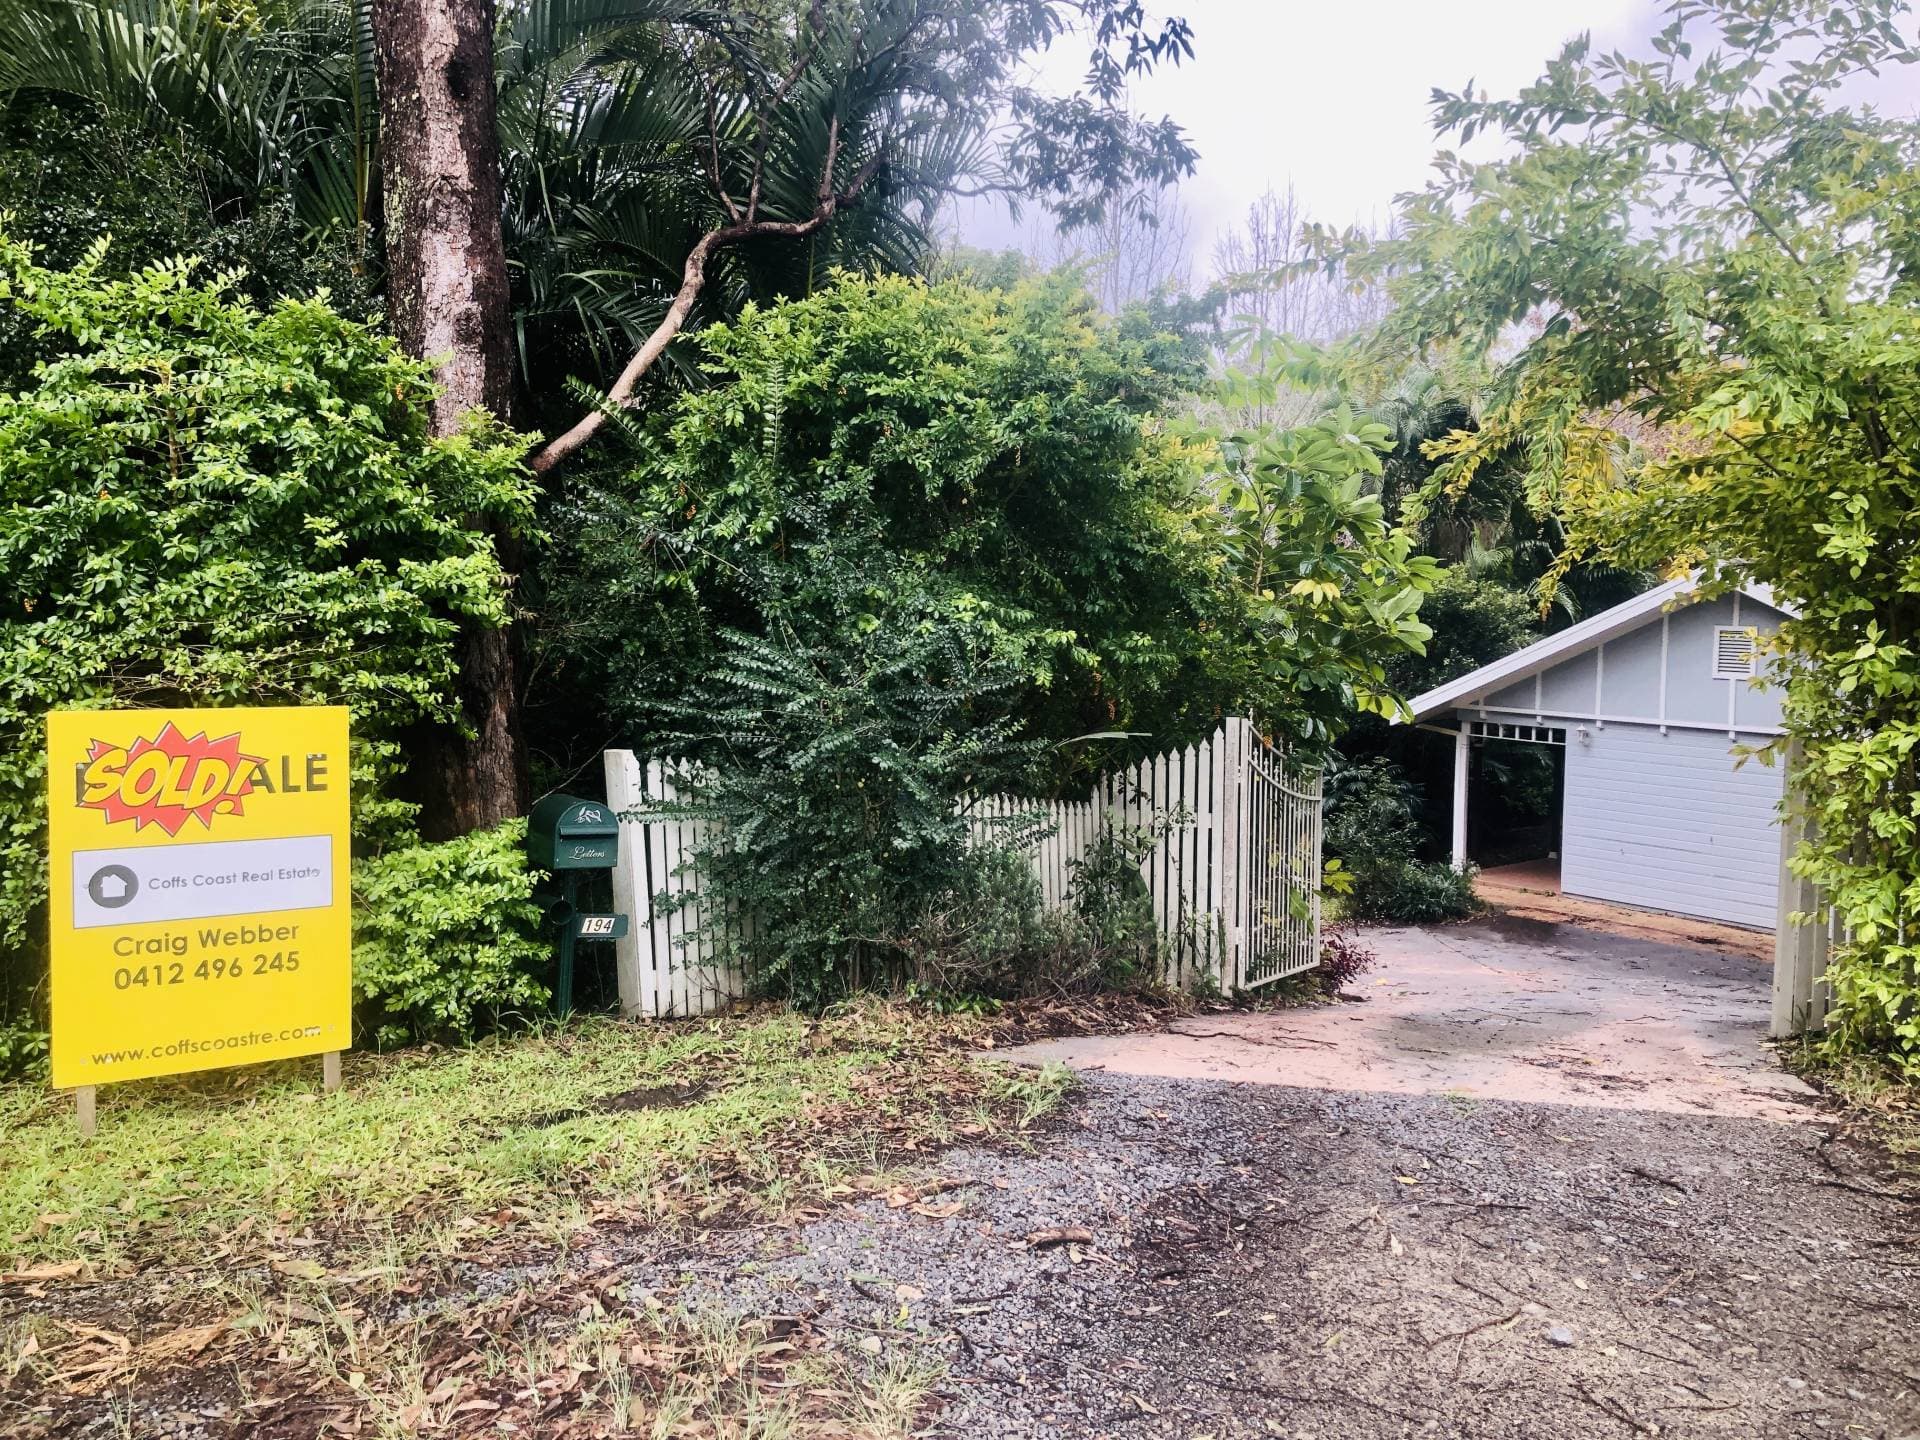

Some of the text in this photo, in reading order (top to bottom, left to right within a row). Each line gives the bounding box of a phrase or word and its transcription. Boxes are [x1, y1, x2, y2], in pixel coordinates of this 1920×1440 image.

[82, 747, 257, 815] SOLD!
[250, 753, 328, 794] ALE
[569, 845, 606, 860] Letters
[148, 867, 320, 890] Coffs Coast Real Estate
[113, 924, 300, 957] Craig Webber
[585, 918, 613, 933] 194
[114, 951, 300, 990] 0412 496 245
[91, 1025, 321, 1066] www.coffscoastre.com
